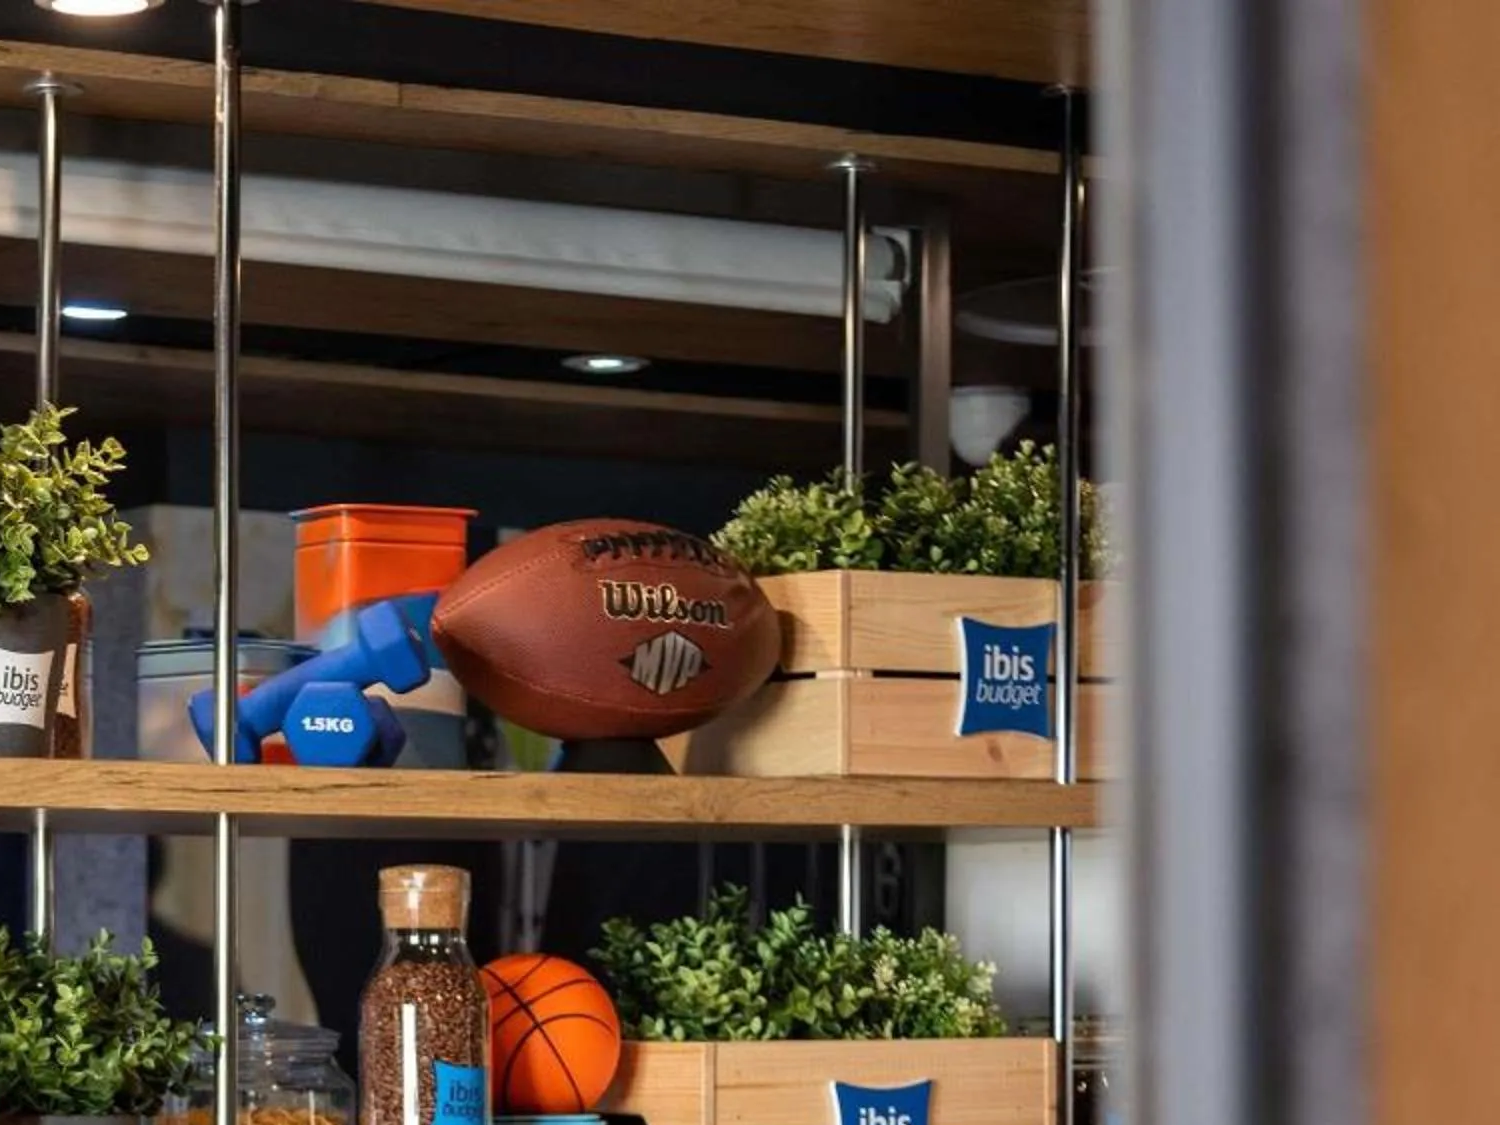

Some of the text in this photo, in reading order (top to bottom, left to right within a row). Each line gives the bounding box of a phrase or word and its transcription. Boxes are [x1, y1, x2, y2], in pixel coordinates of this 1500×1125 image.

[598, 579, 733, 629] Wilson
[3, 665, 39, 691] ibis
[631, 631, 704, 695] MVP
[984, 644, 1035, 681] ibis
[976, 678, 1042, 710] budget
[301, 716, 354, 733] 1.5KG
